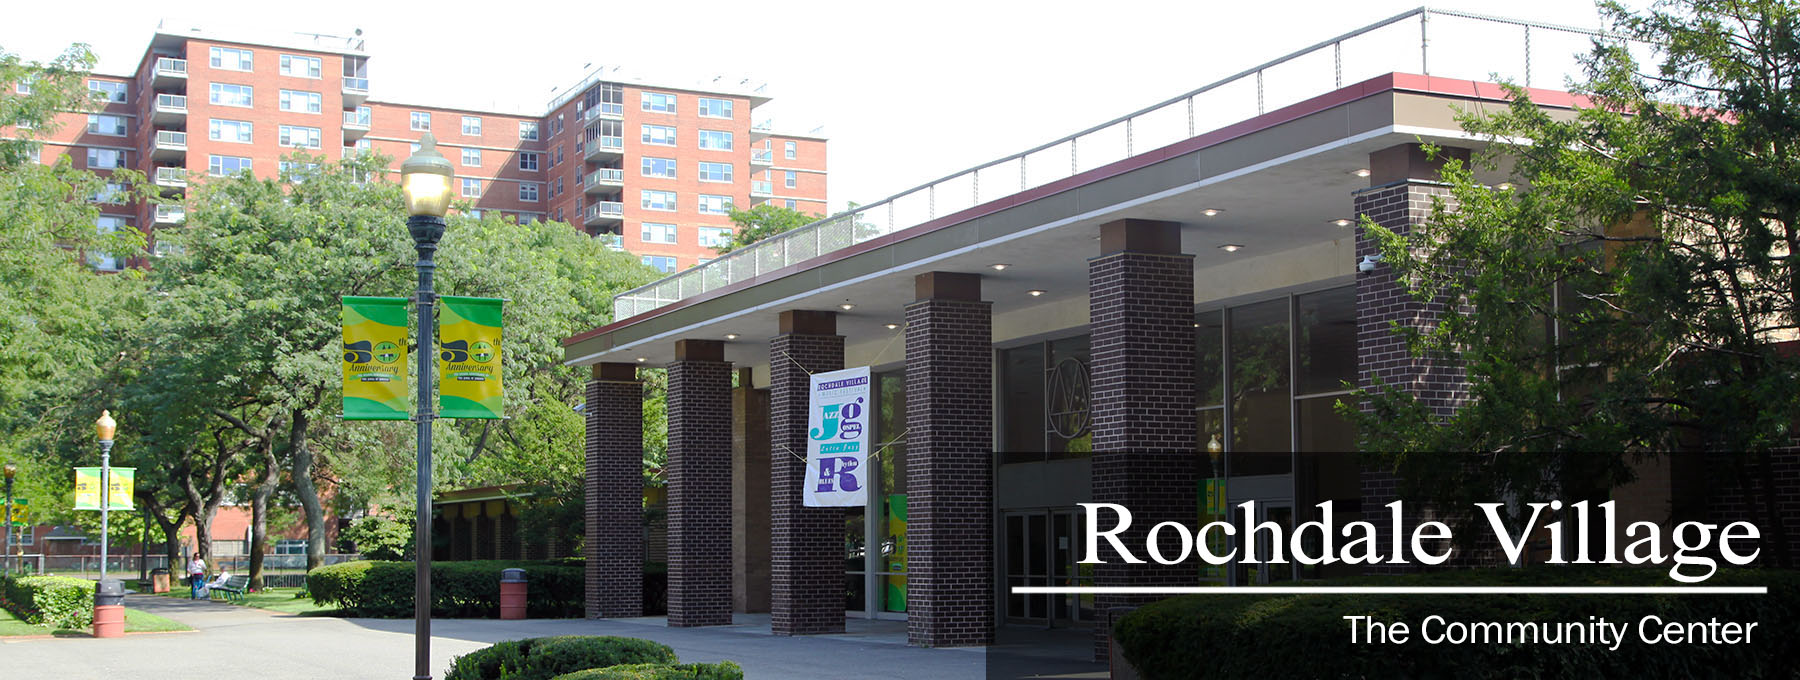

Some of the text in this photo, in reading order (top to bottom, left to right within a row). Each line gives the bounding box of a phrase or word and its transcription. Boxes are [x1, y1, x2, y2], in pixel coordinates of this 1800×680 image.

[349, 363, 399, 374] Anniversary
[446, 362, 493, 374] Anniversary
[846, 376, 868, 386] VILLAGE
